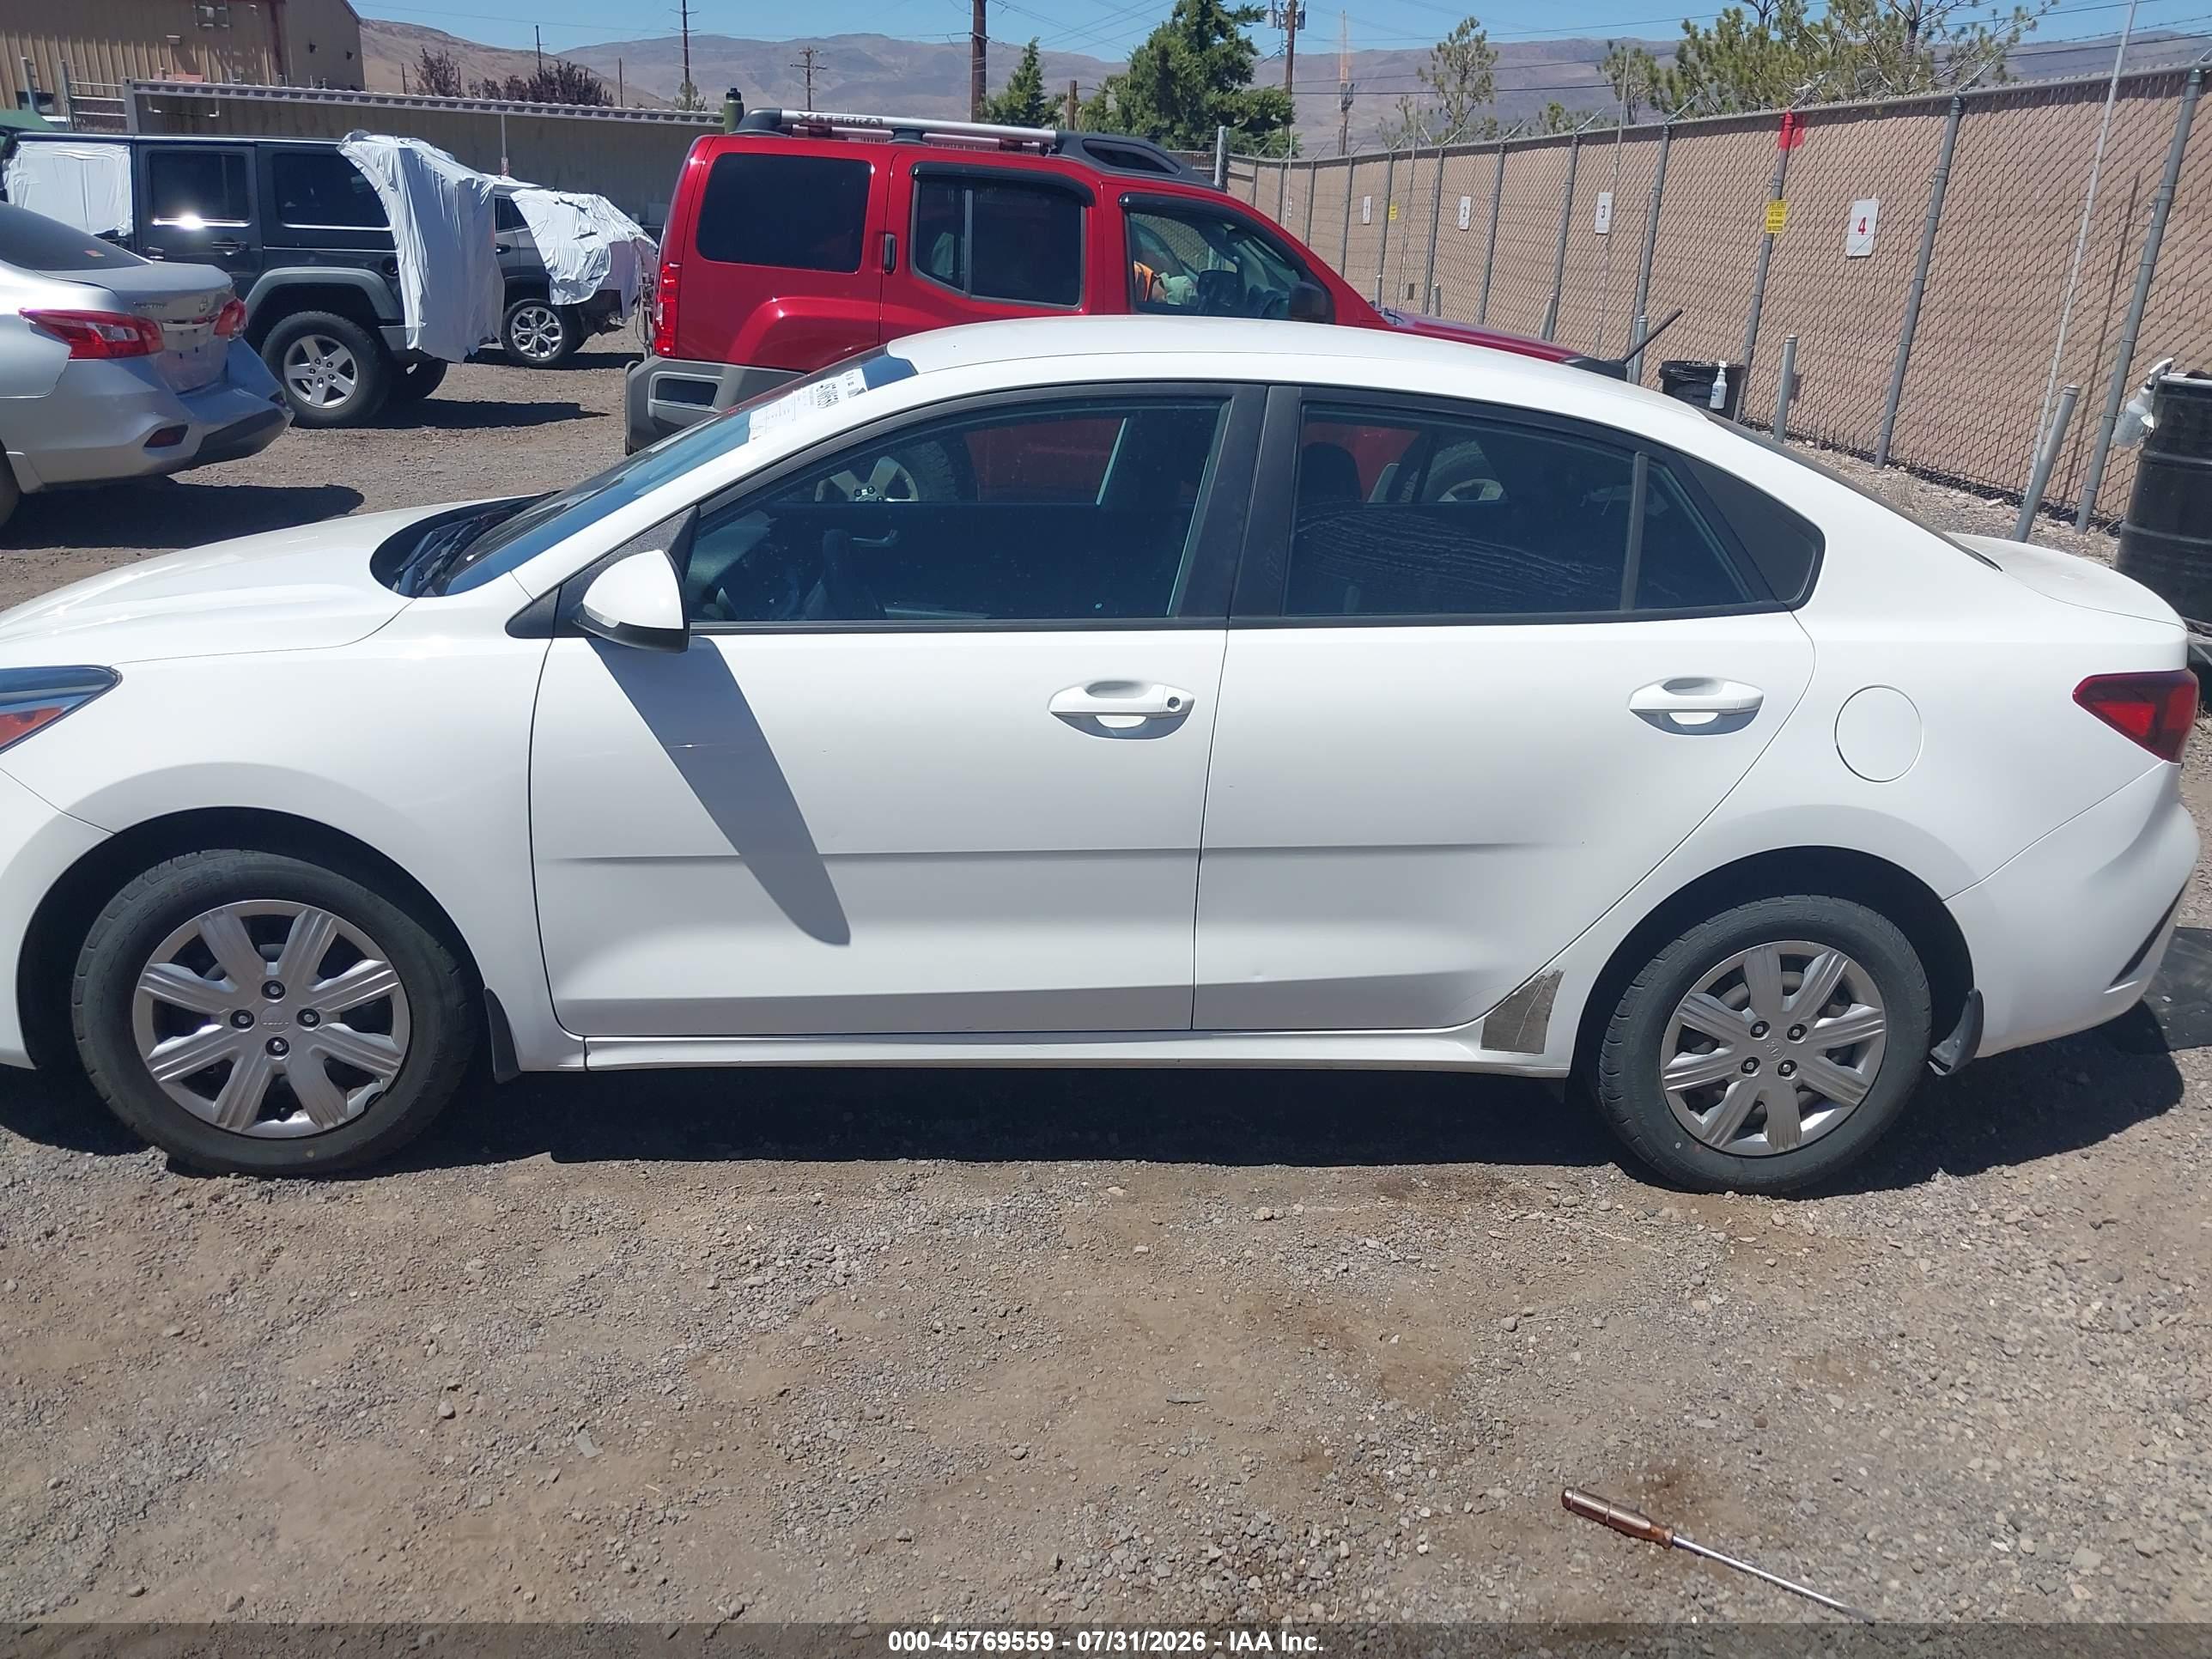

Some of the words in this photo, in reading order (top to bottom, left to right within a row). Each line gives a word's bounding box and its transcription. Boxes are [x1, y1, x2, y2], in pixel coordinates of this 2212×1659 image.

[1462, 205, 1467, 217] 2
[1601, 204, 1607, 219] 3
[1857, 216, 1867, 235] 4
